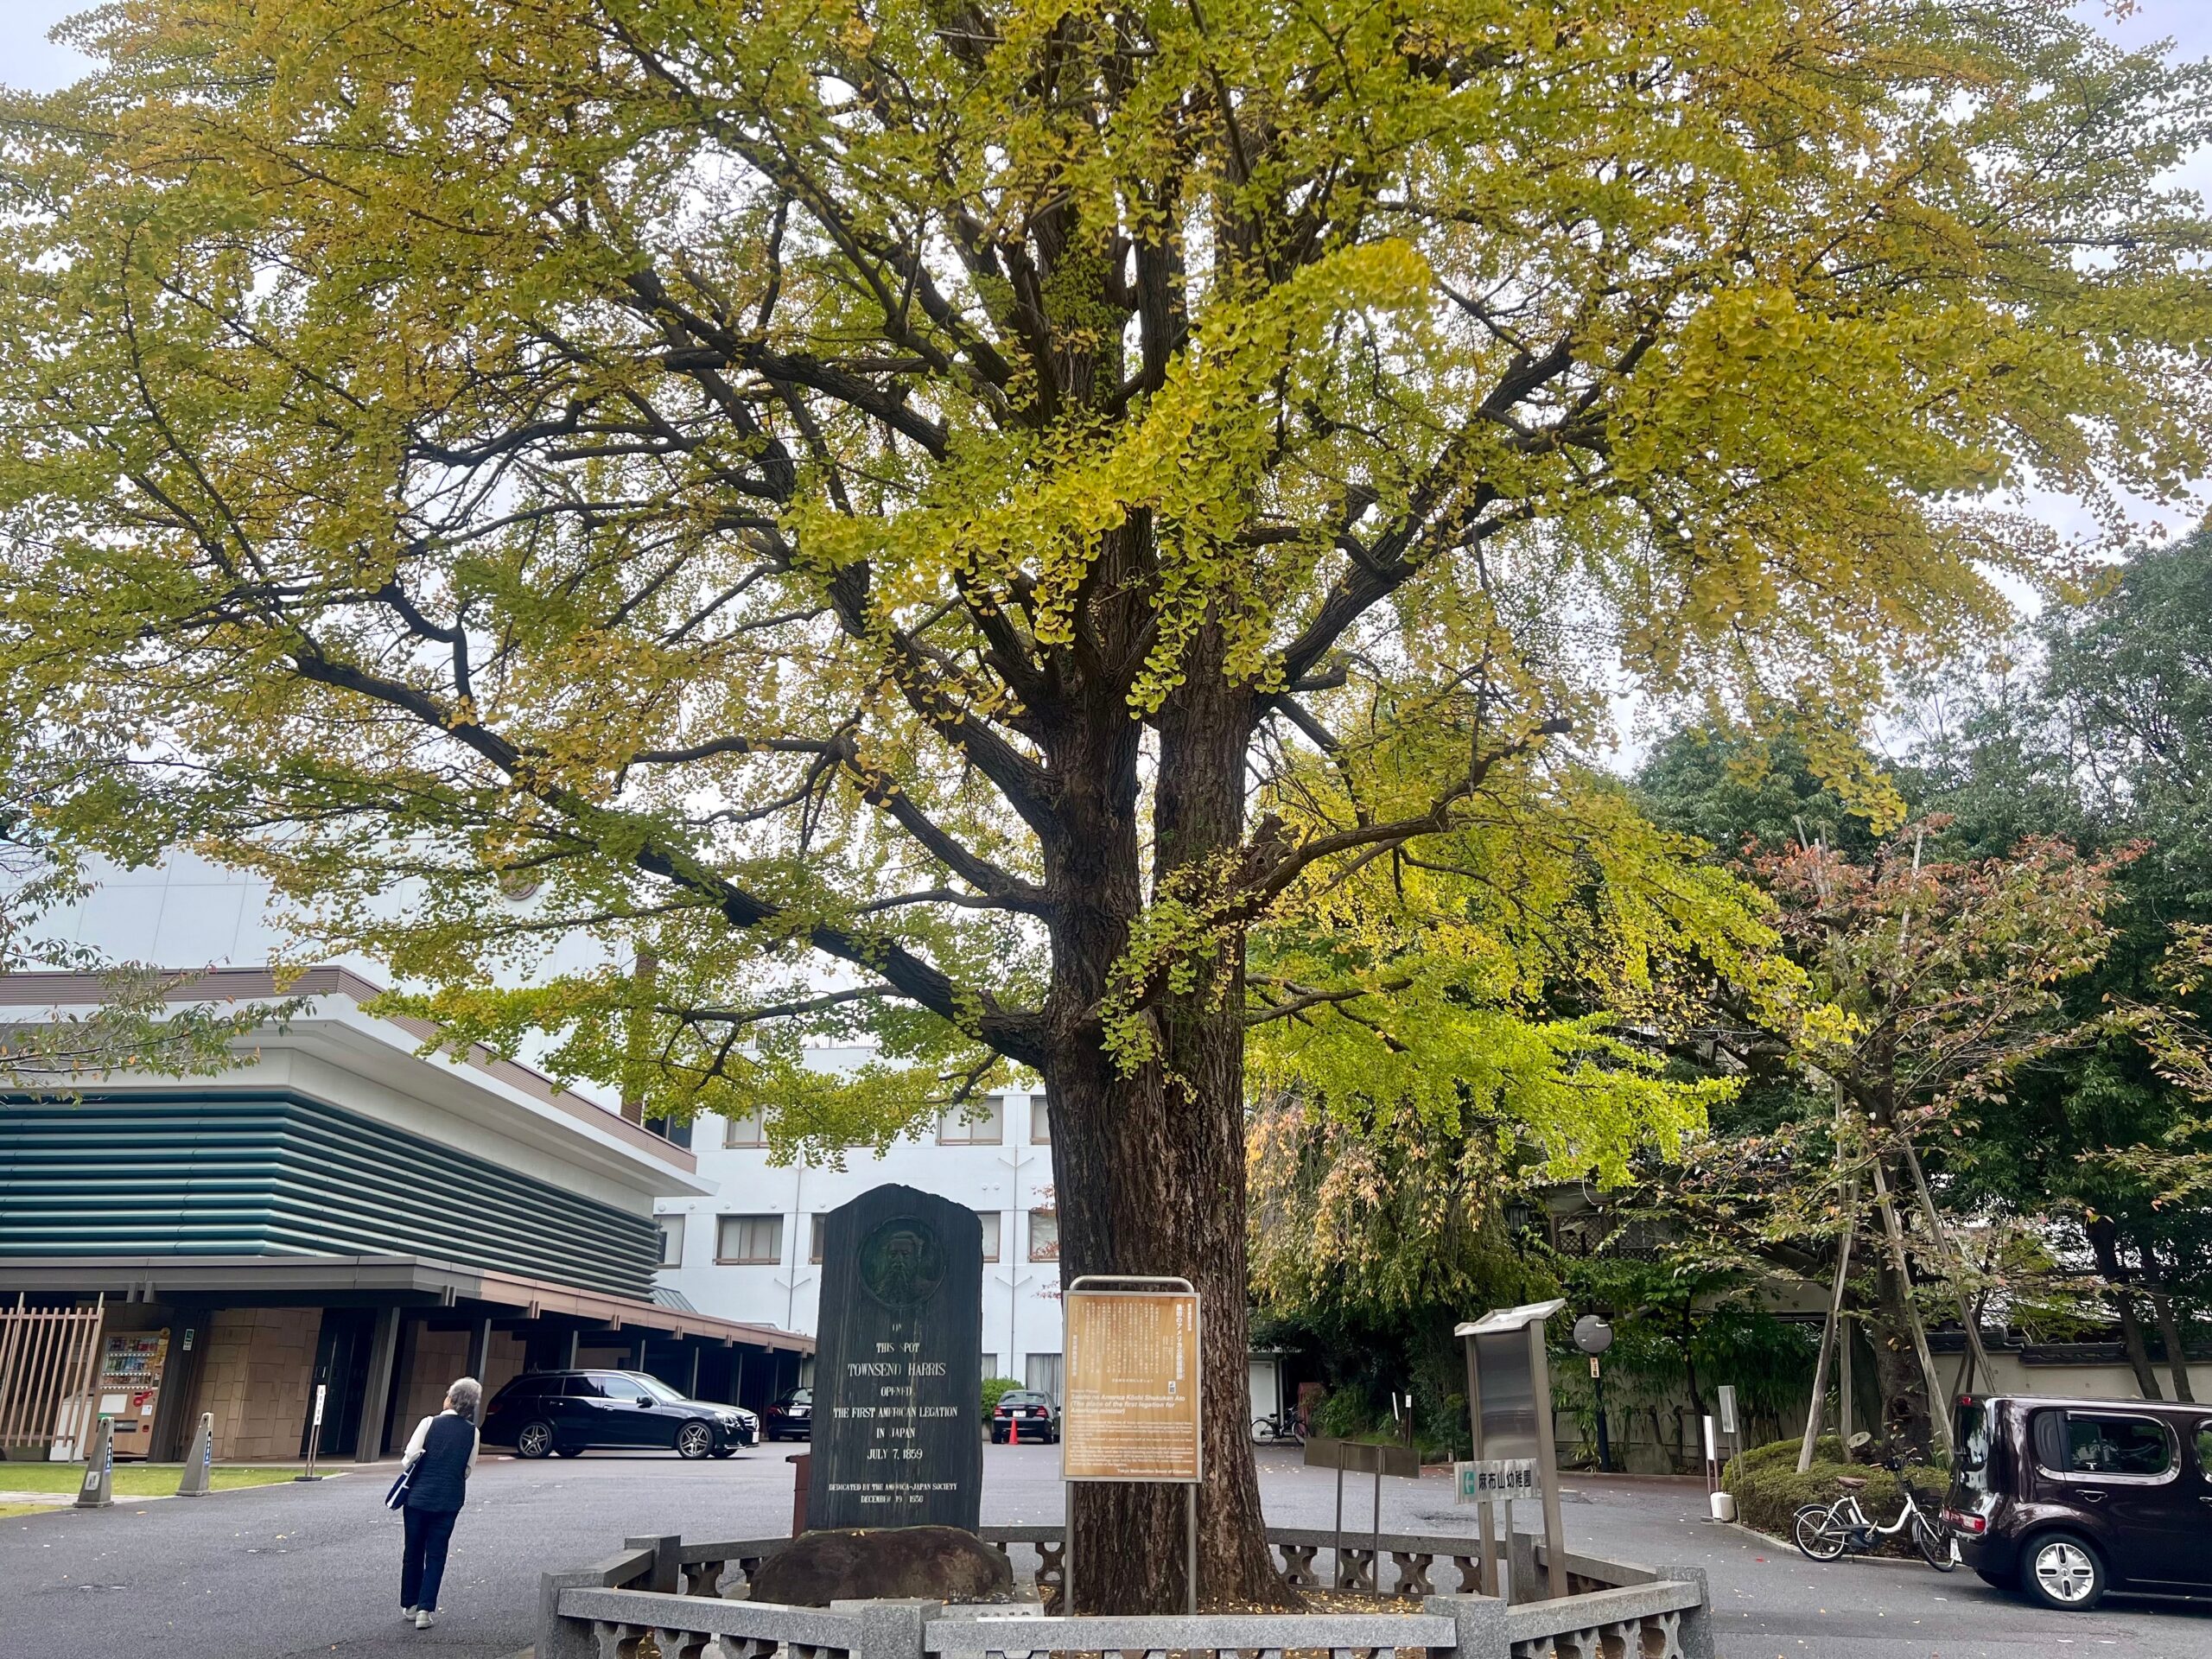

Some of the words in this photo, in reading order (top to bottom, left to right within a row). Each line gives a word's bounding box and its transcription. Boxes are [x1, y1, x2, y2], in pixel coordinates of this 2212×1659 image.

[876, 1342, 894, 1353] THIS
[848, 1363, 901, 1377] TOWNSEND
[908, 1362, 946, 1376] HARRIS
[880, 1386, 912, 1397] OPENED
[833, 1407, 849, 1419] THE
[851, 1407, 875, 1419] FIRST
[878, 1407, 917, 1418] AMERICAN
[919, 1406, 958, 1418] LEGATION
[876, 1427, 885, 1439] IN
[890, 1427, 916, 1439] JAPAN
[867, 1448, 887, 1459] JULY
[893, 1448, 899, 1460] 7,
[903, 1448, 923, 1459] 1859
[1478, 1470, 1532, 1491] 麻布山幼稚園
[829, 1483, 861, 1491] DEDICATED
[862, 1483, 870, 1491] BY
[861, 1495, 891, 1503] DECEMBER
